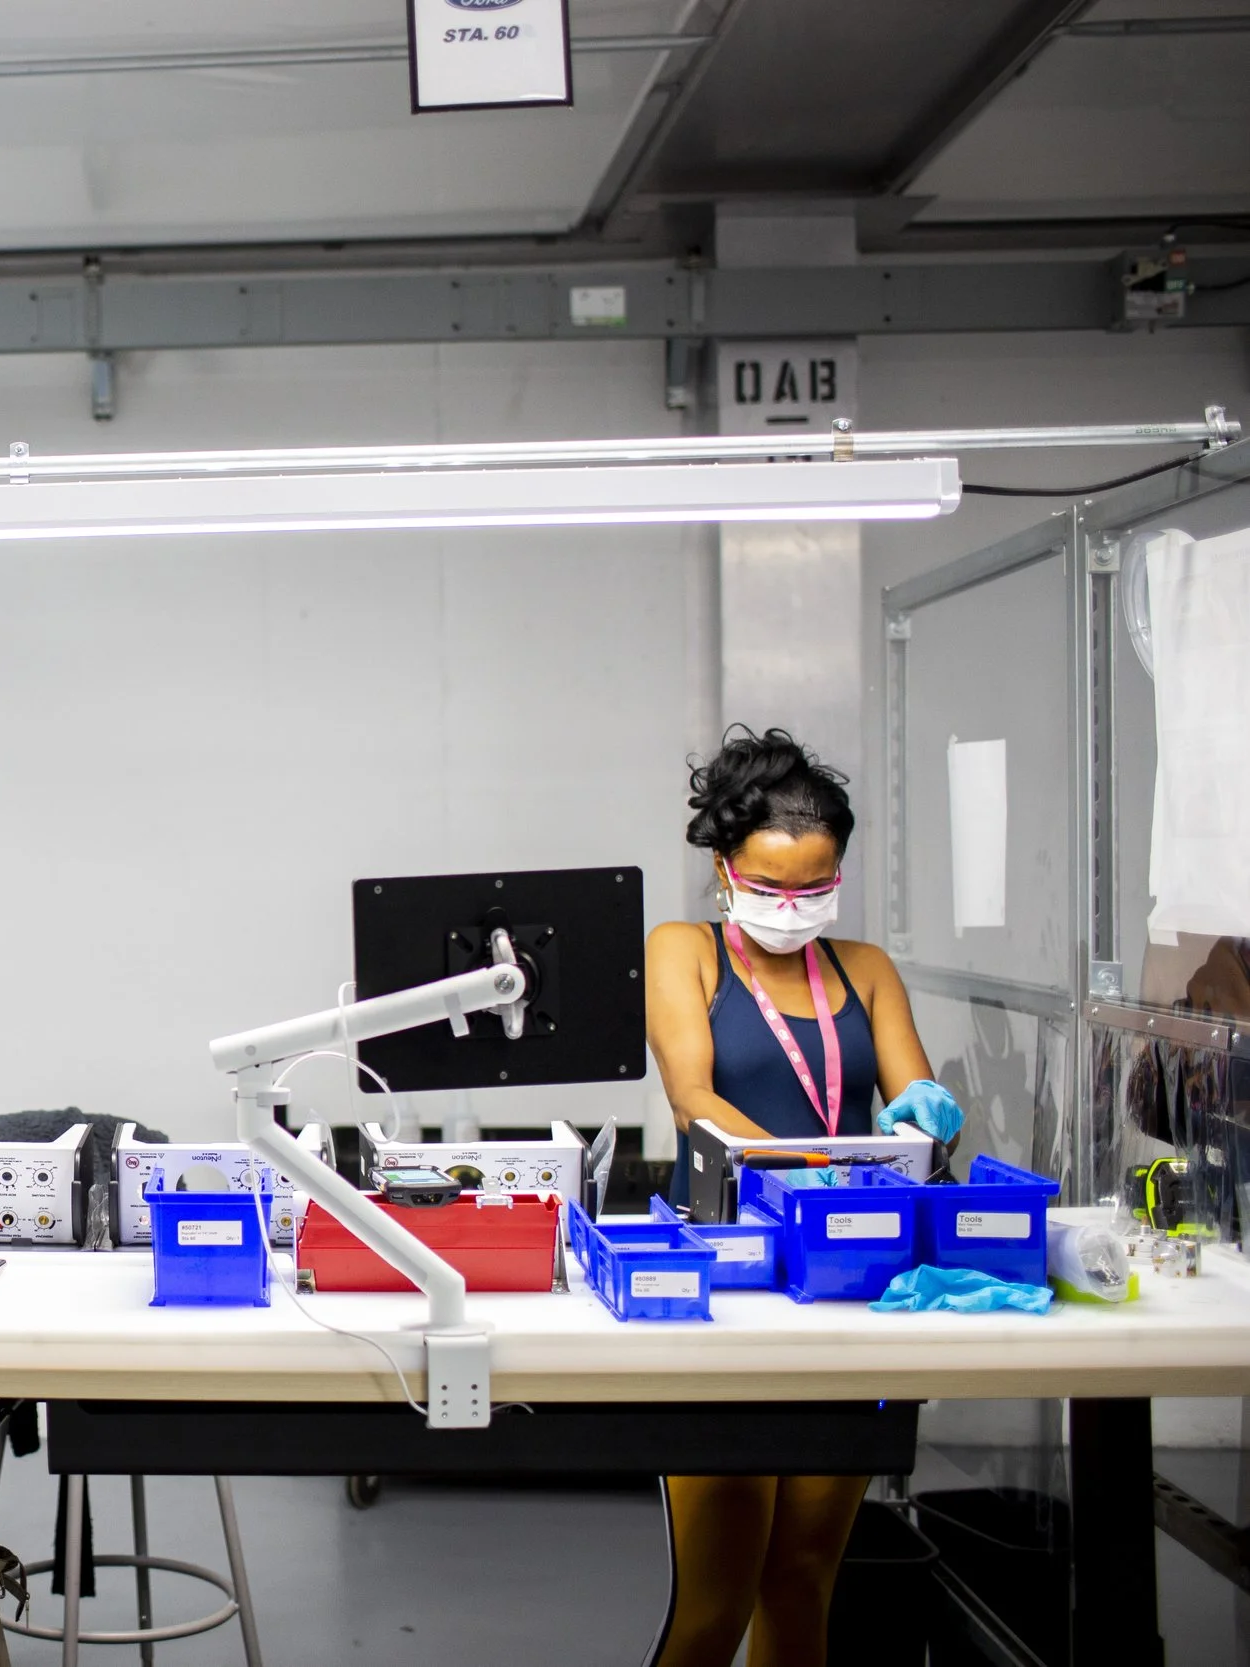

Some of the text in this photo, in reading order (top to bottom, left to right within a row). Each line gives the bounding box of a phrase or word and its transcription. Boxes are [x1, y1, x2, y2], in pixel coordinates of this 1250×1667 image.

[443, 25, 520, 43] STA. 60
[829, 1216, 852, 1224] Tools
[959, 1215, 983, 1223] Tools
